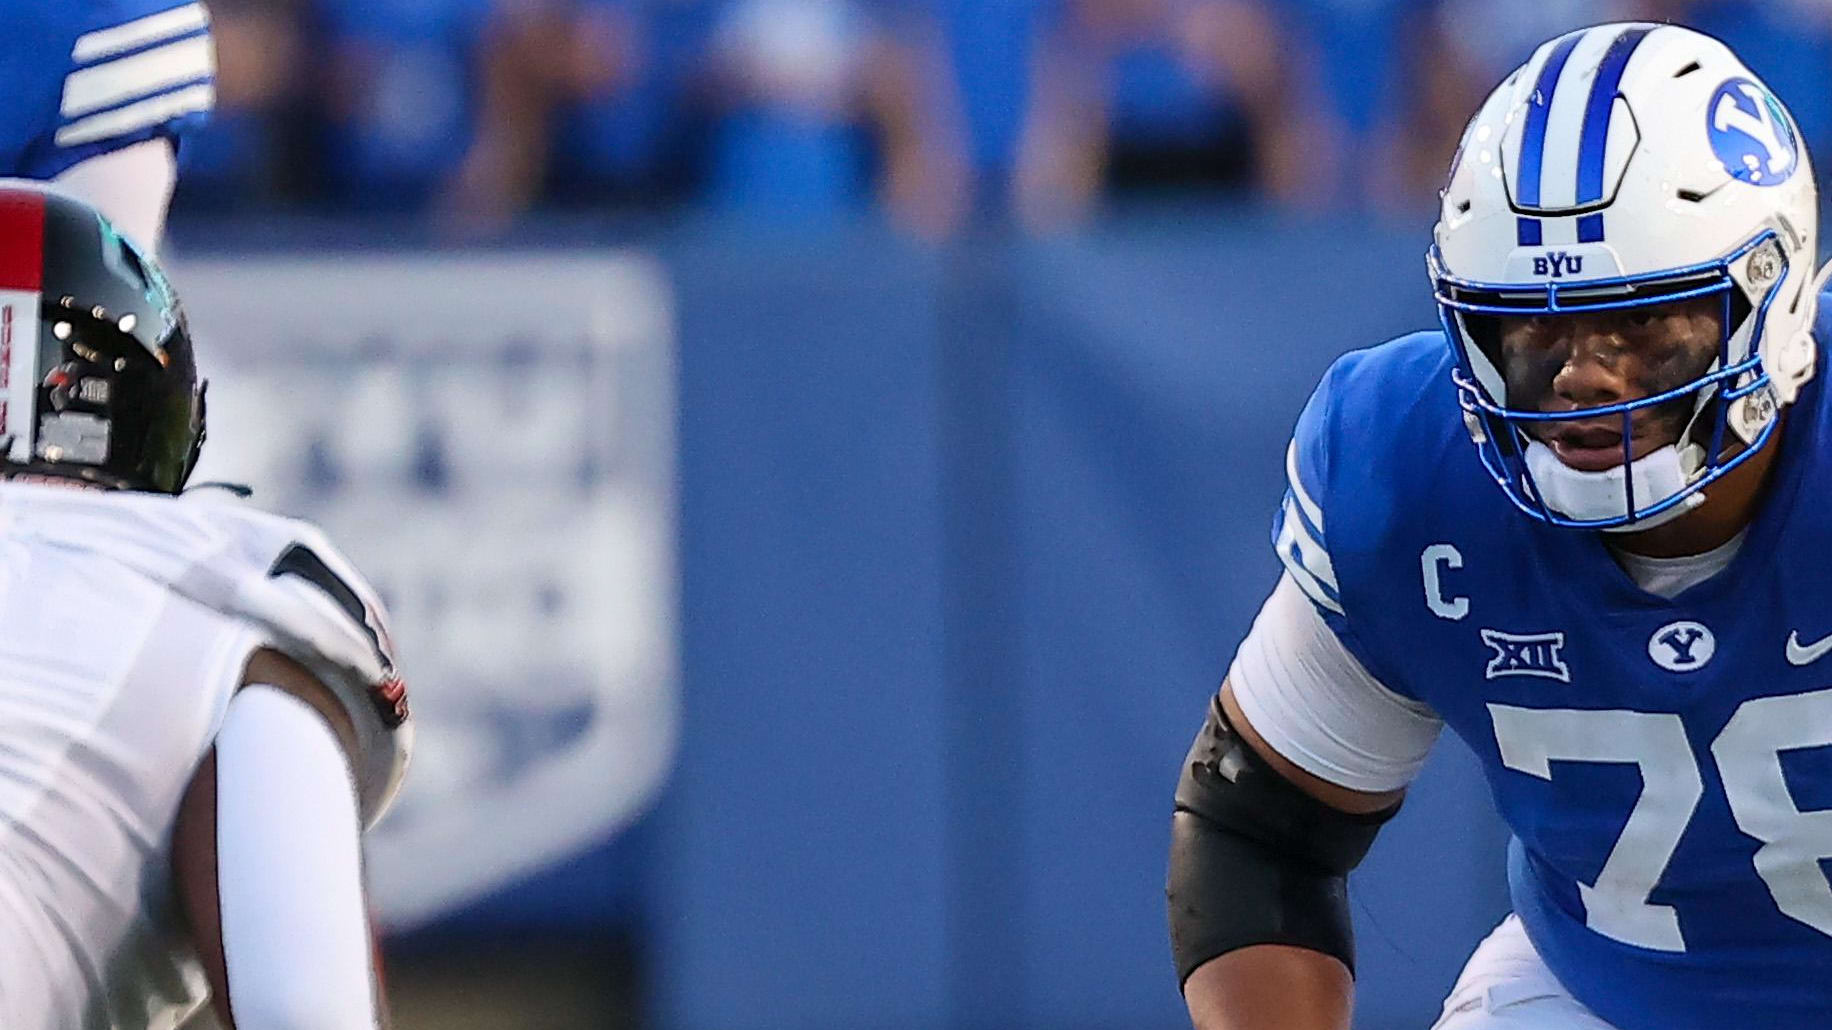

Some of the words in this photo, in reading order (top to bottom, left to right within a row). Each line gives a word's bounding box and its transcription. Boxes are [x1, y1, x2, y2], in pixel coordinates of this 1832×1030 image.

[1714, 83, 1793, 175] Y
[1533, 251, 1583, 278] BYU
[1421, 544, 1469, 620] C
[1481, 629, 1569, 682] XII
[1658, 626, 1704, 665] Y
